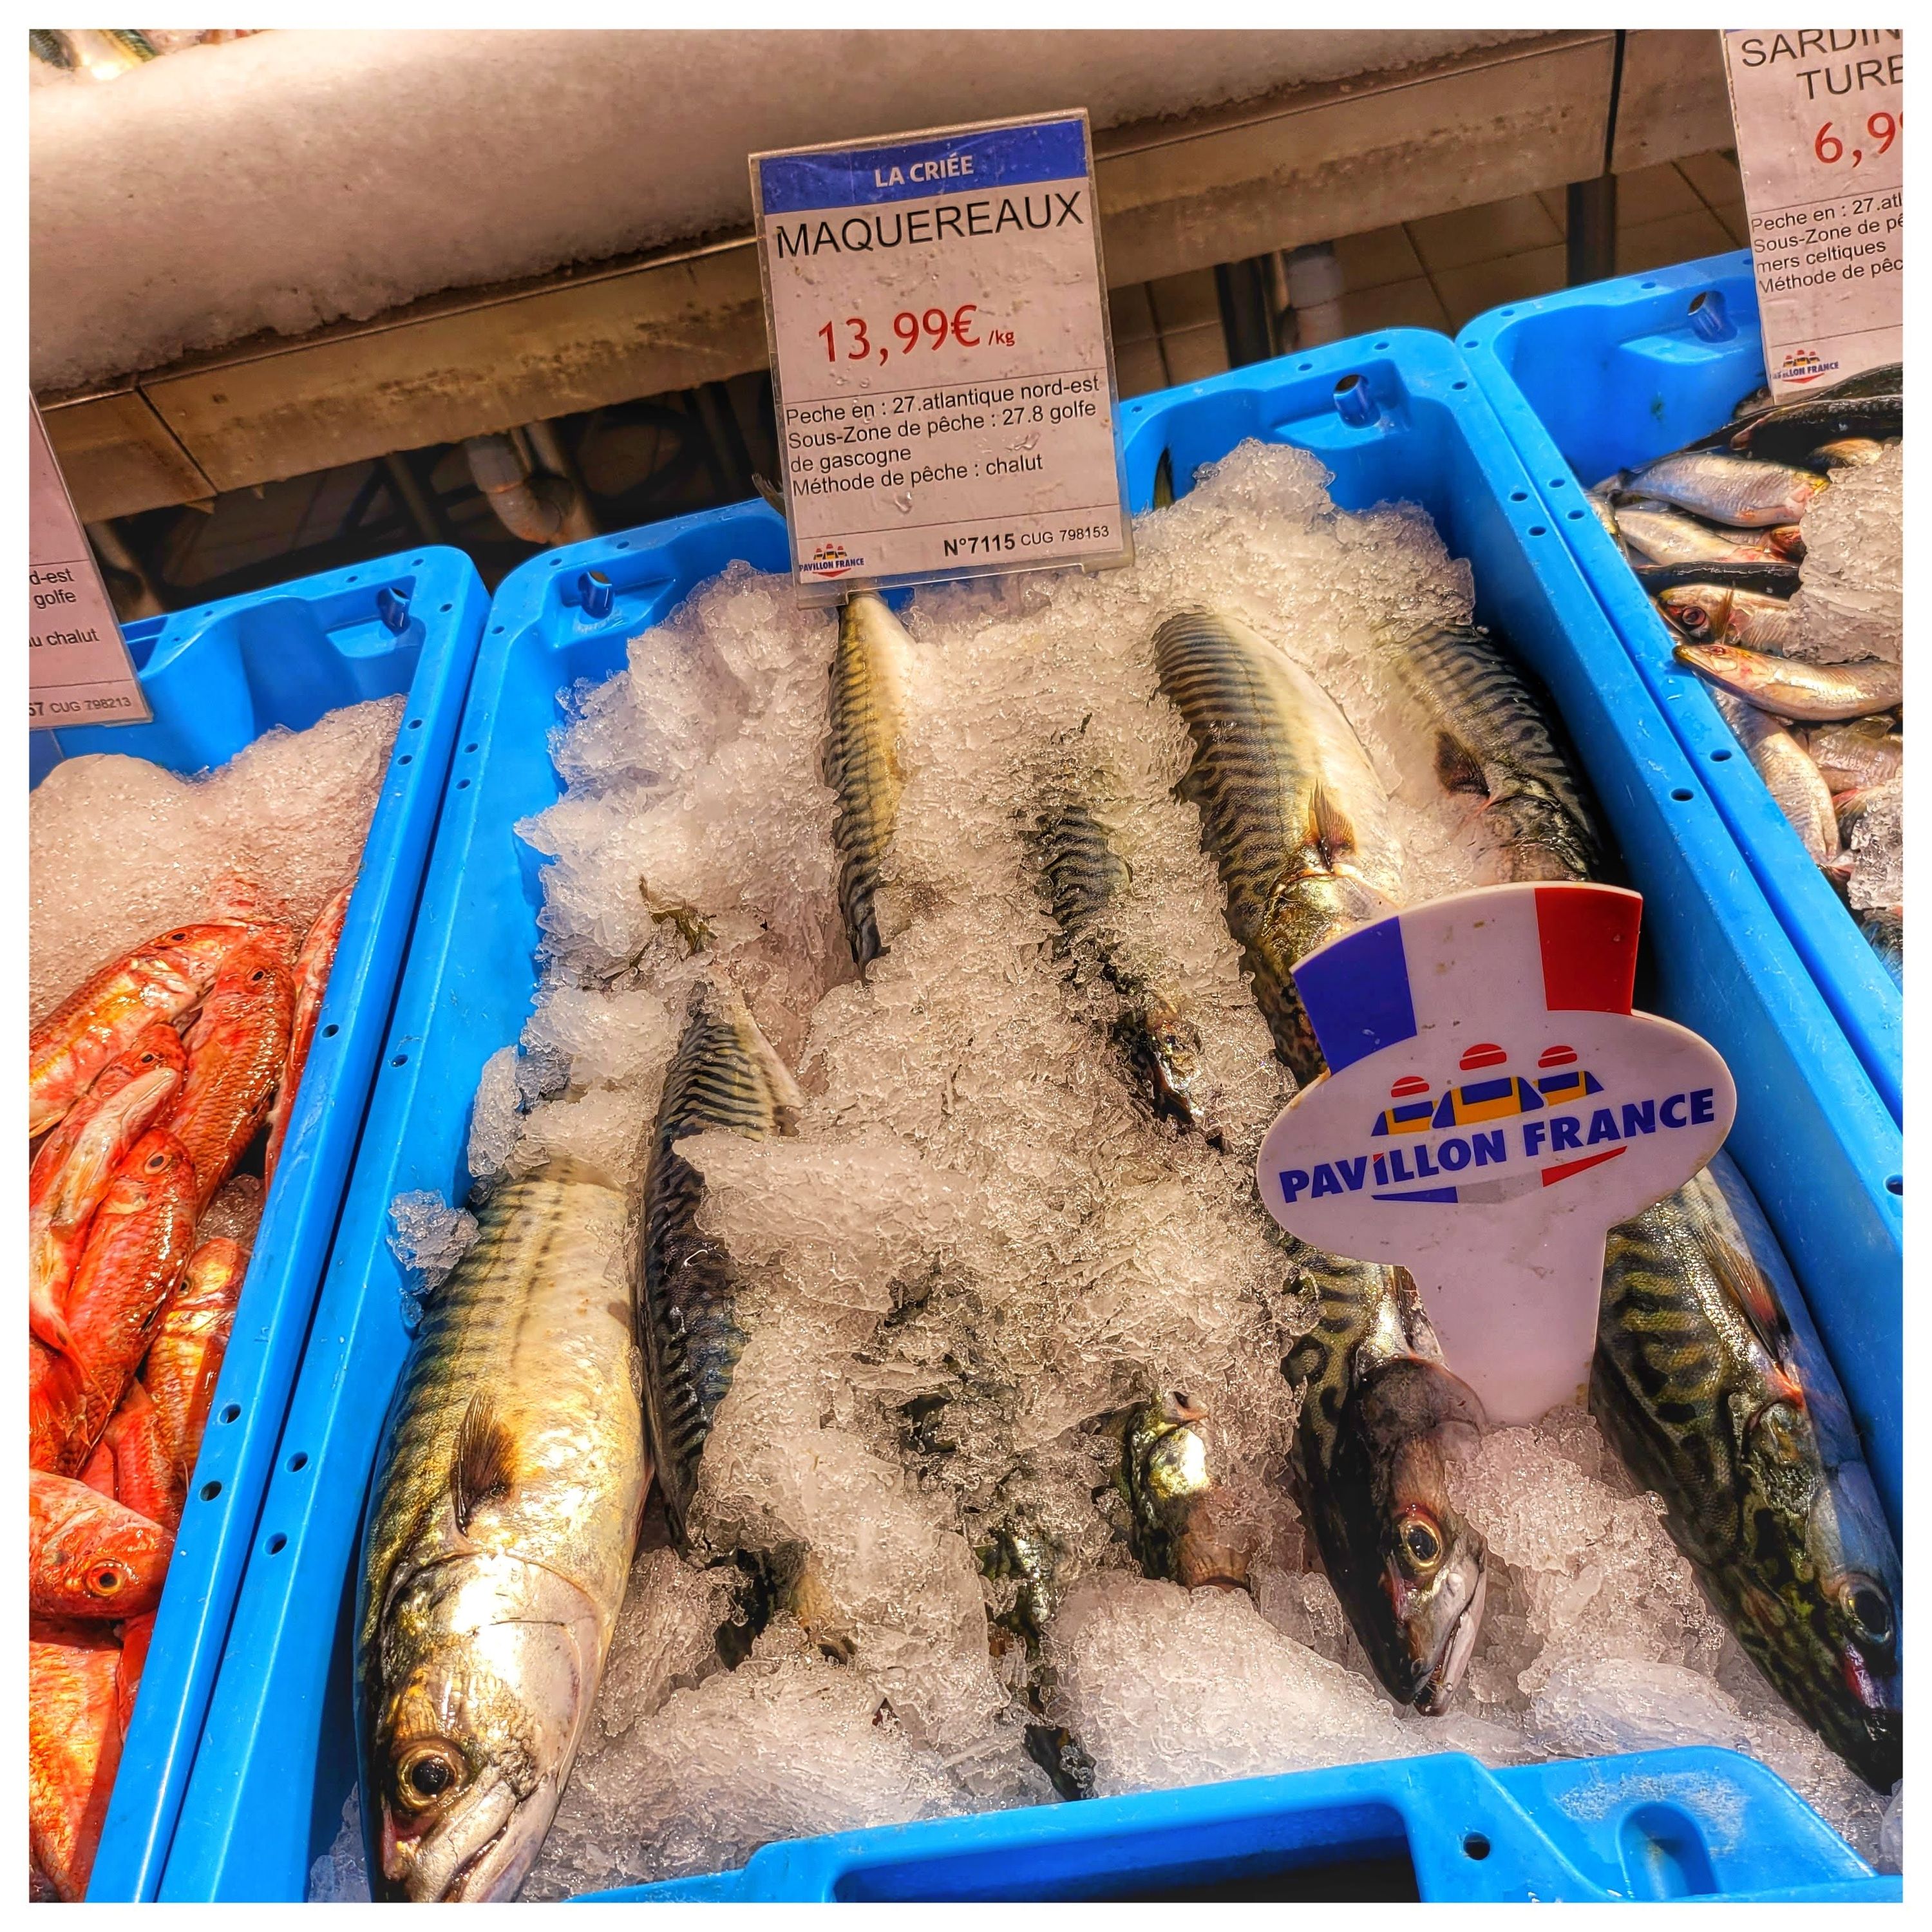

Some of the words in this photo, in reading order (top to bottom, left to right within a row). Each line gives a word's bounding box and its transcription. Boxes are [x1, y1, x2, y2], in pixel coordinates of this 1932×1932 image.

[1815, 111, 1902, 168] 6,9
[875, 167, 905, 187] LA
[909, 154, 974, 183] CRIÉE
[777, 191, 1083, 258] MAQUEREAUX
[1751, 213, 1807, 232] Peche
[1814, 208, 1835, 222] en
[1754, 228, 1852, 253] Sous-Zone
[1858, 220, 1880, 234] de
[1757, 257, 1800, 273] mers
[1806, 241, 1886, 265] celtiques
[1842, 265, 1864, 279] de
[819, 305, 980, 366] 13,99€
[988, 330, 1016, 347] /kg
[1807, 361, 1839, 374] FRANCE
[786, 404, 845, 425] Peche
[852, 402, 875, 419] en
[893, 388, 1014, 414] 27.atlantique
[1021, 375, 1099, 399] nord-est
[789, 426, 891, 448] Sous-Zone
[897, 420, 921, 437] de
[927, 412, 985, 439] pêche
[1003, 405, 1044, 426] 27.8
[1050, 399, 1096, 424] golfe
[791, 455, 813, 473] de
[820, 448, 911, 474] gascogne
[793, 472, 875, 497] Méthode
[880, 469, 904, 487] de
[911, 462, 968, 488] pêche
[985, 453, 1043, 475] chalut
[943, 533, 1016, 556] N°7115
[1021, 531, 1054, 546] CUG
[1059, 526, 1110, 542] 798153
[30, 568, 75, 585] d-est
[799, 561, 834, 573] PAVILLON
[835, 558, 865, 568] FRANCE
[33, 589, 77, 609] golfe
[46, 629, 100, 646] chalut
[50, 701, 81, 714] CUG
[84, 697, 131, 710] 798213
[1280, 1130, 1506, 1204] PAVILLON
[1524, 1088, 1714, 1156] FRANCE
